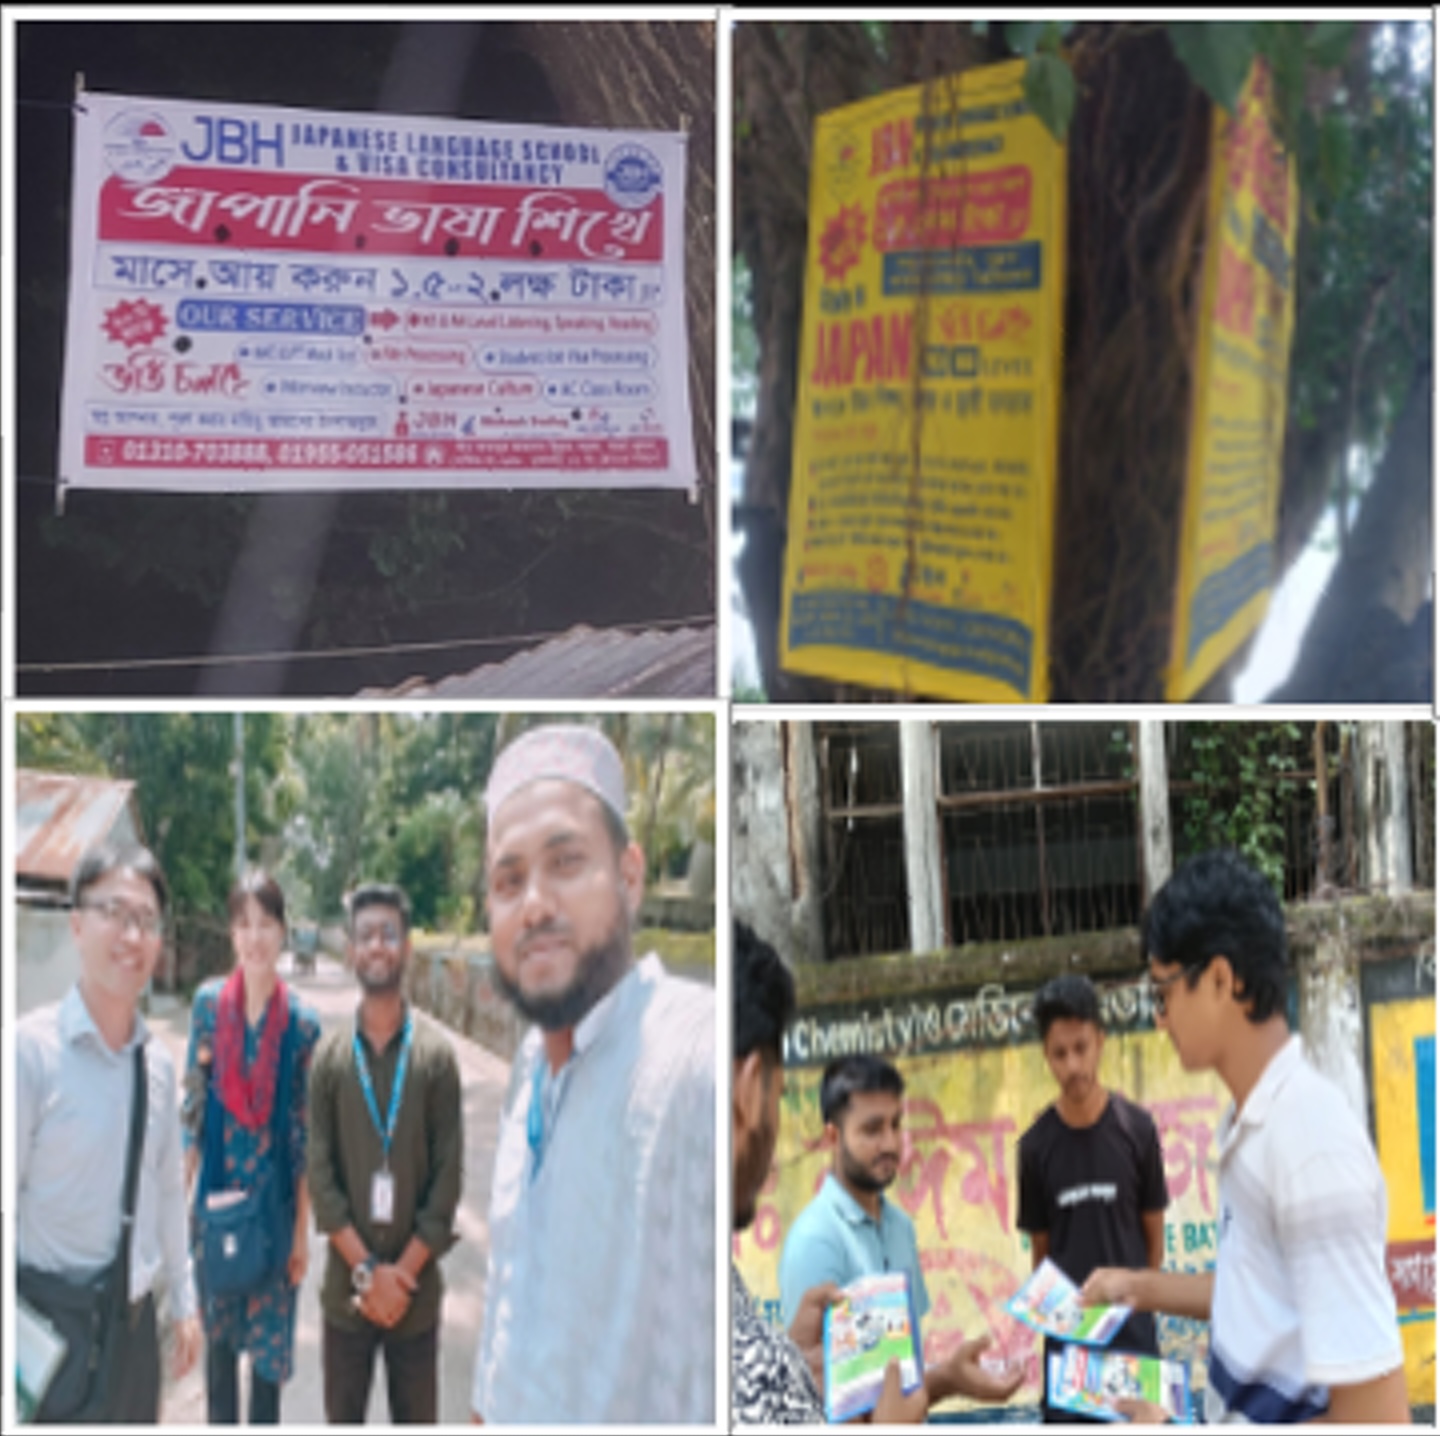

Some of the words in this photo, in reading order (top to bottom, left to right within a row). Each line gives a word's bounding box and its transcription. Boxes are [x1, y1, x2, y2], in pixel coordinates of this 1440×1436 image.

[180, 115, 284, 168] JBH
[291, 122, 398, 153] JAPANESE
[408, 132, 514, 161] LANGUAGE
[522, 140, 601, 165] SCHOOL
[335, 154, 349, 172] &
[357, 152, 409, 177] VISA
[416, 157, 565, 186] CONSULTANCY
[116, 179, 361, 237] জাপানি
[370, 199, 506, 244] ভাষা
[511, 190, 654, 259] শিখে
[111, 255, 197, 288] মাসে
[208, 259, 280, 290] আয়
[287, 263, 379, 294] করুন
[499, 271, 560, 300] লক্ষ
[181, 303, 238, 326] OUR
[246, 306, 363, 334] SERVICE
[811, 311, 914, 391] JAPAN
[1183, 1222, 1219, 1252] BAT
